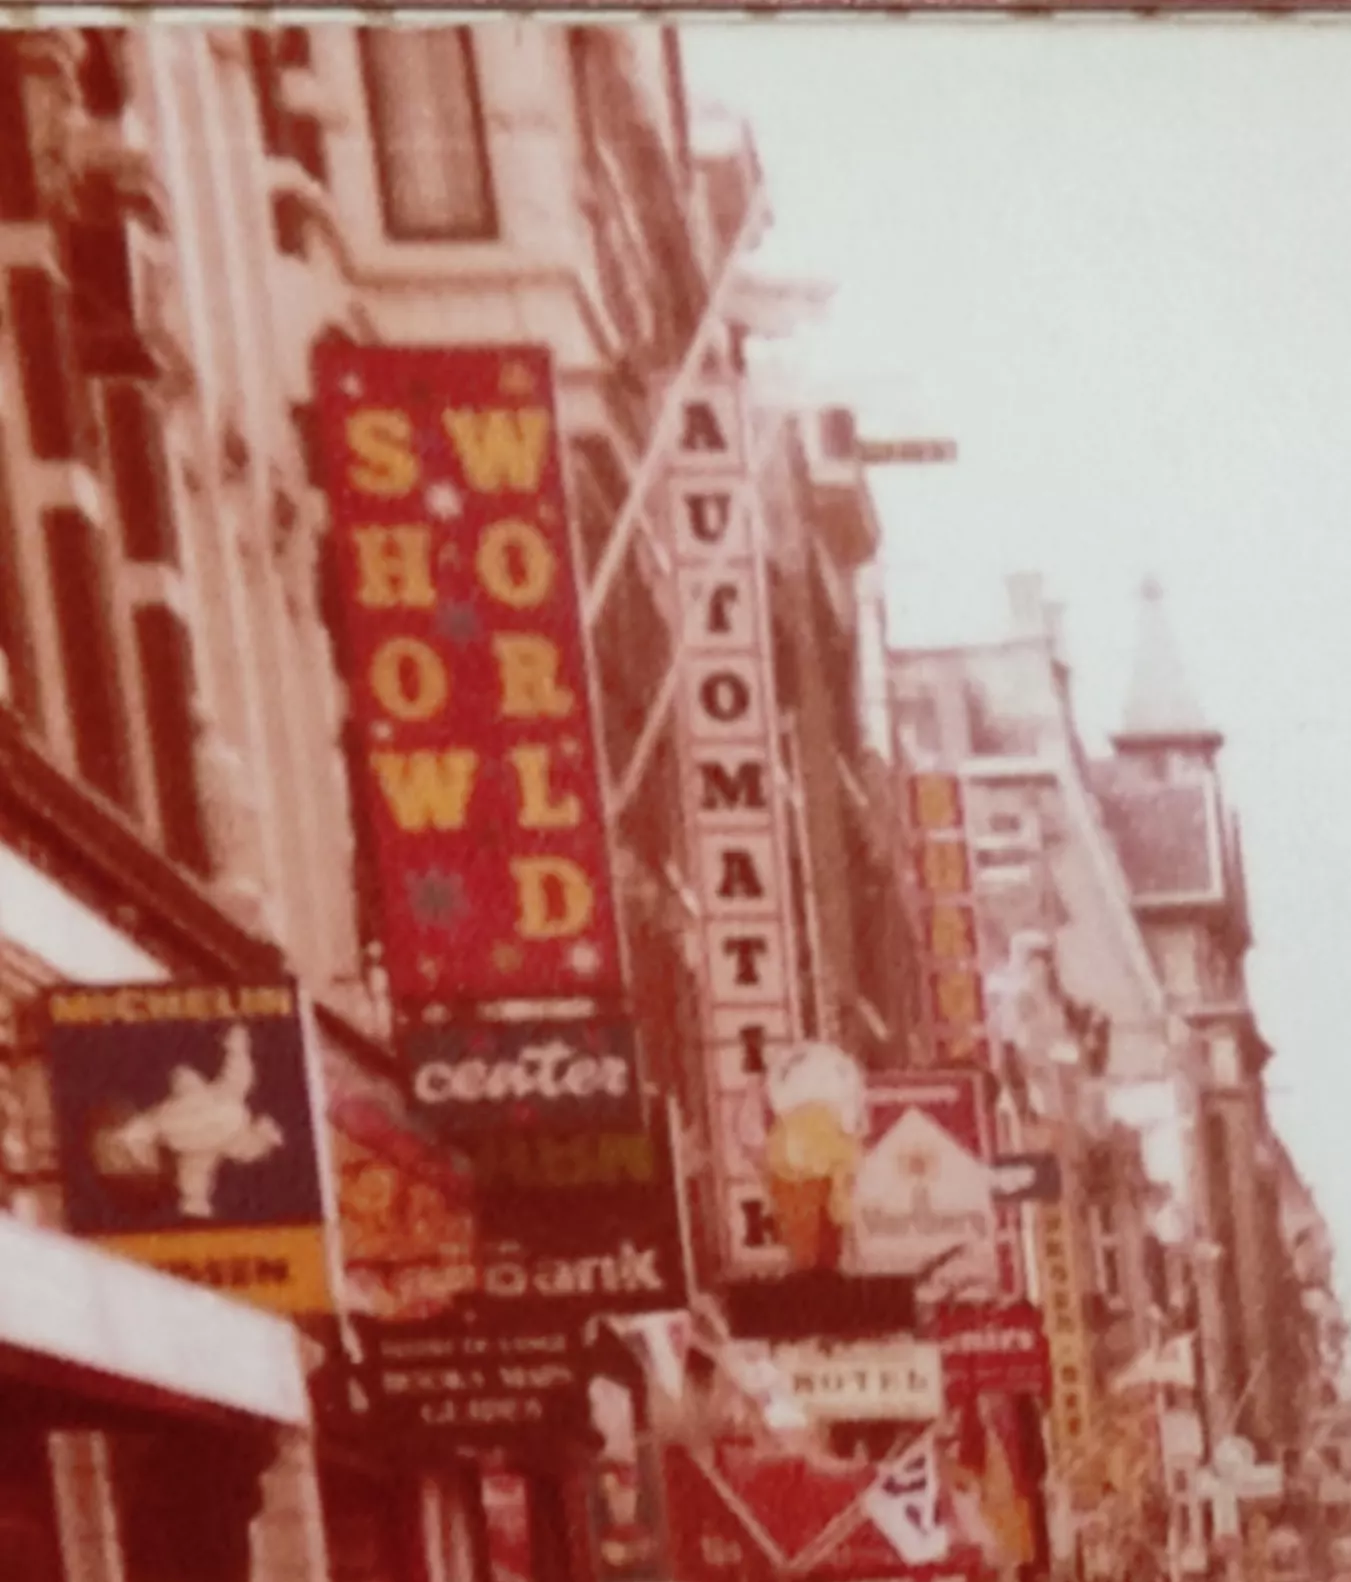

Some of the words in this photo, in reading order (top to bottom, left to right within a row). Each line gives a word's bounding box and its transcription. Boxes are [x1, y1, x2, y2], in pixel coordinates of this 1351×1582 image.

[344, 408, 478, 832] SHOW
[441, 404, 596, 939] WORLD
[680, 402, 785, 1249] AUTOMATIK
[791, 1368, 928, 1394] HOTEL
